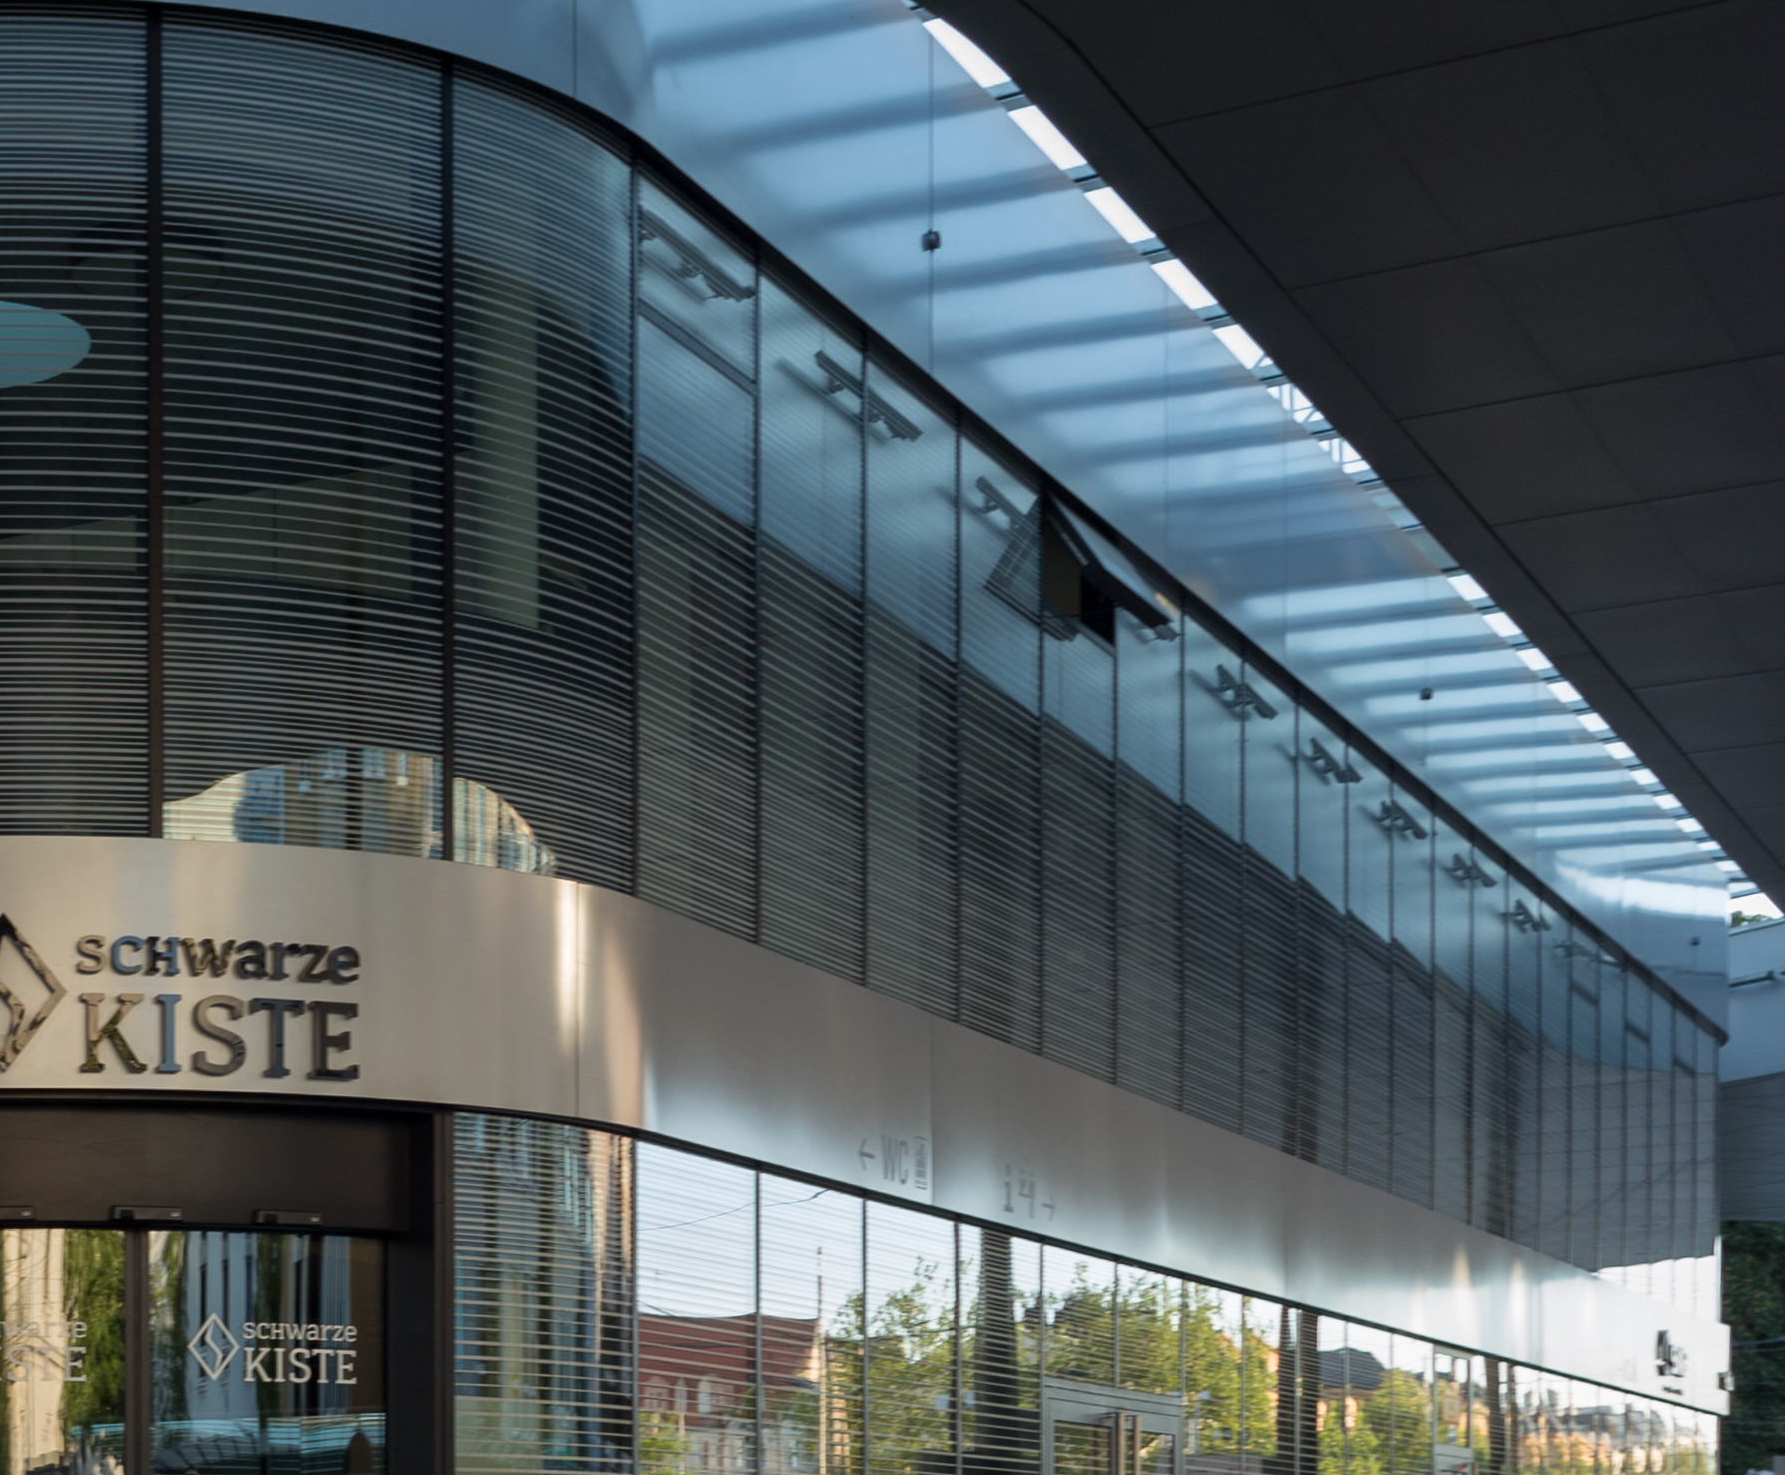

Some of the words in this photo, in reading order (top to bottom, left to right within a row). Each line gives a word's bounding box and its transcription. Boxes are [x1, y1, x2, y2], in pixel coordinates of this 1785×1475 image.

[78, 992, 361, 1081] KISTE
[881, 1134, 909, 1185] WC
[243, 1347, 358, 1385] KISTE
